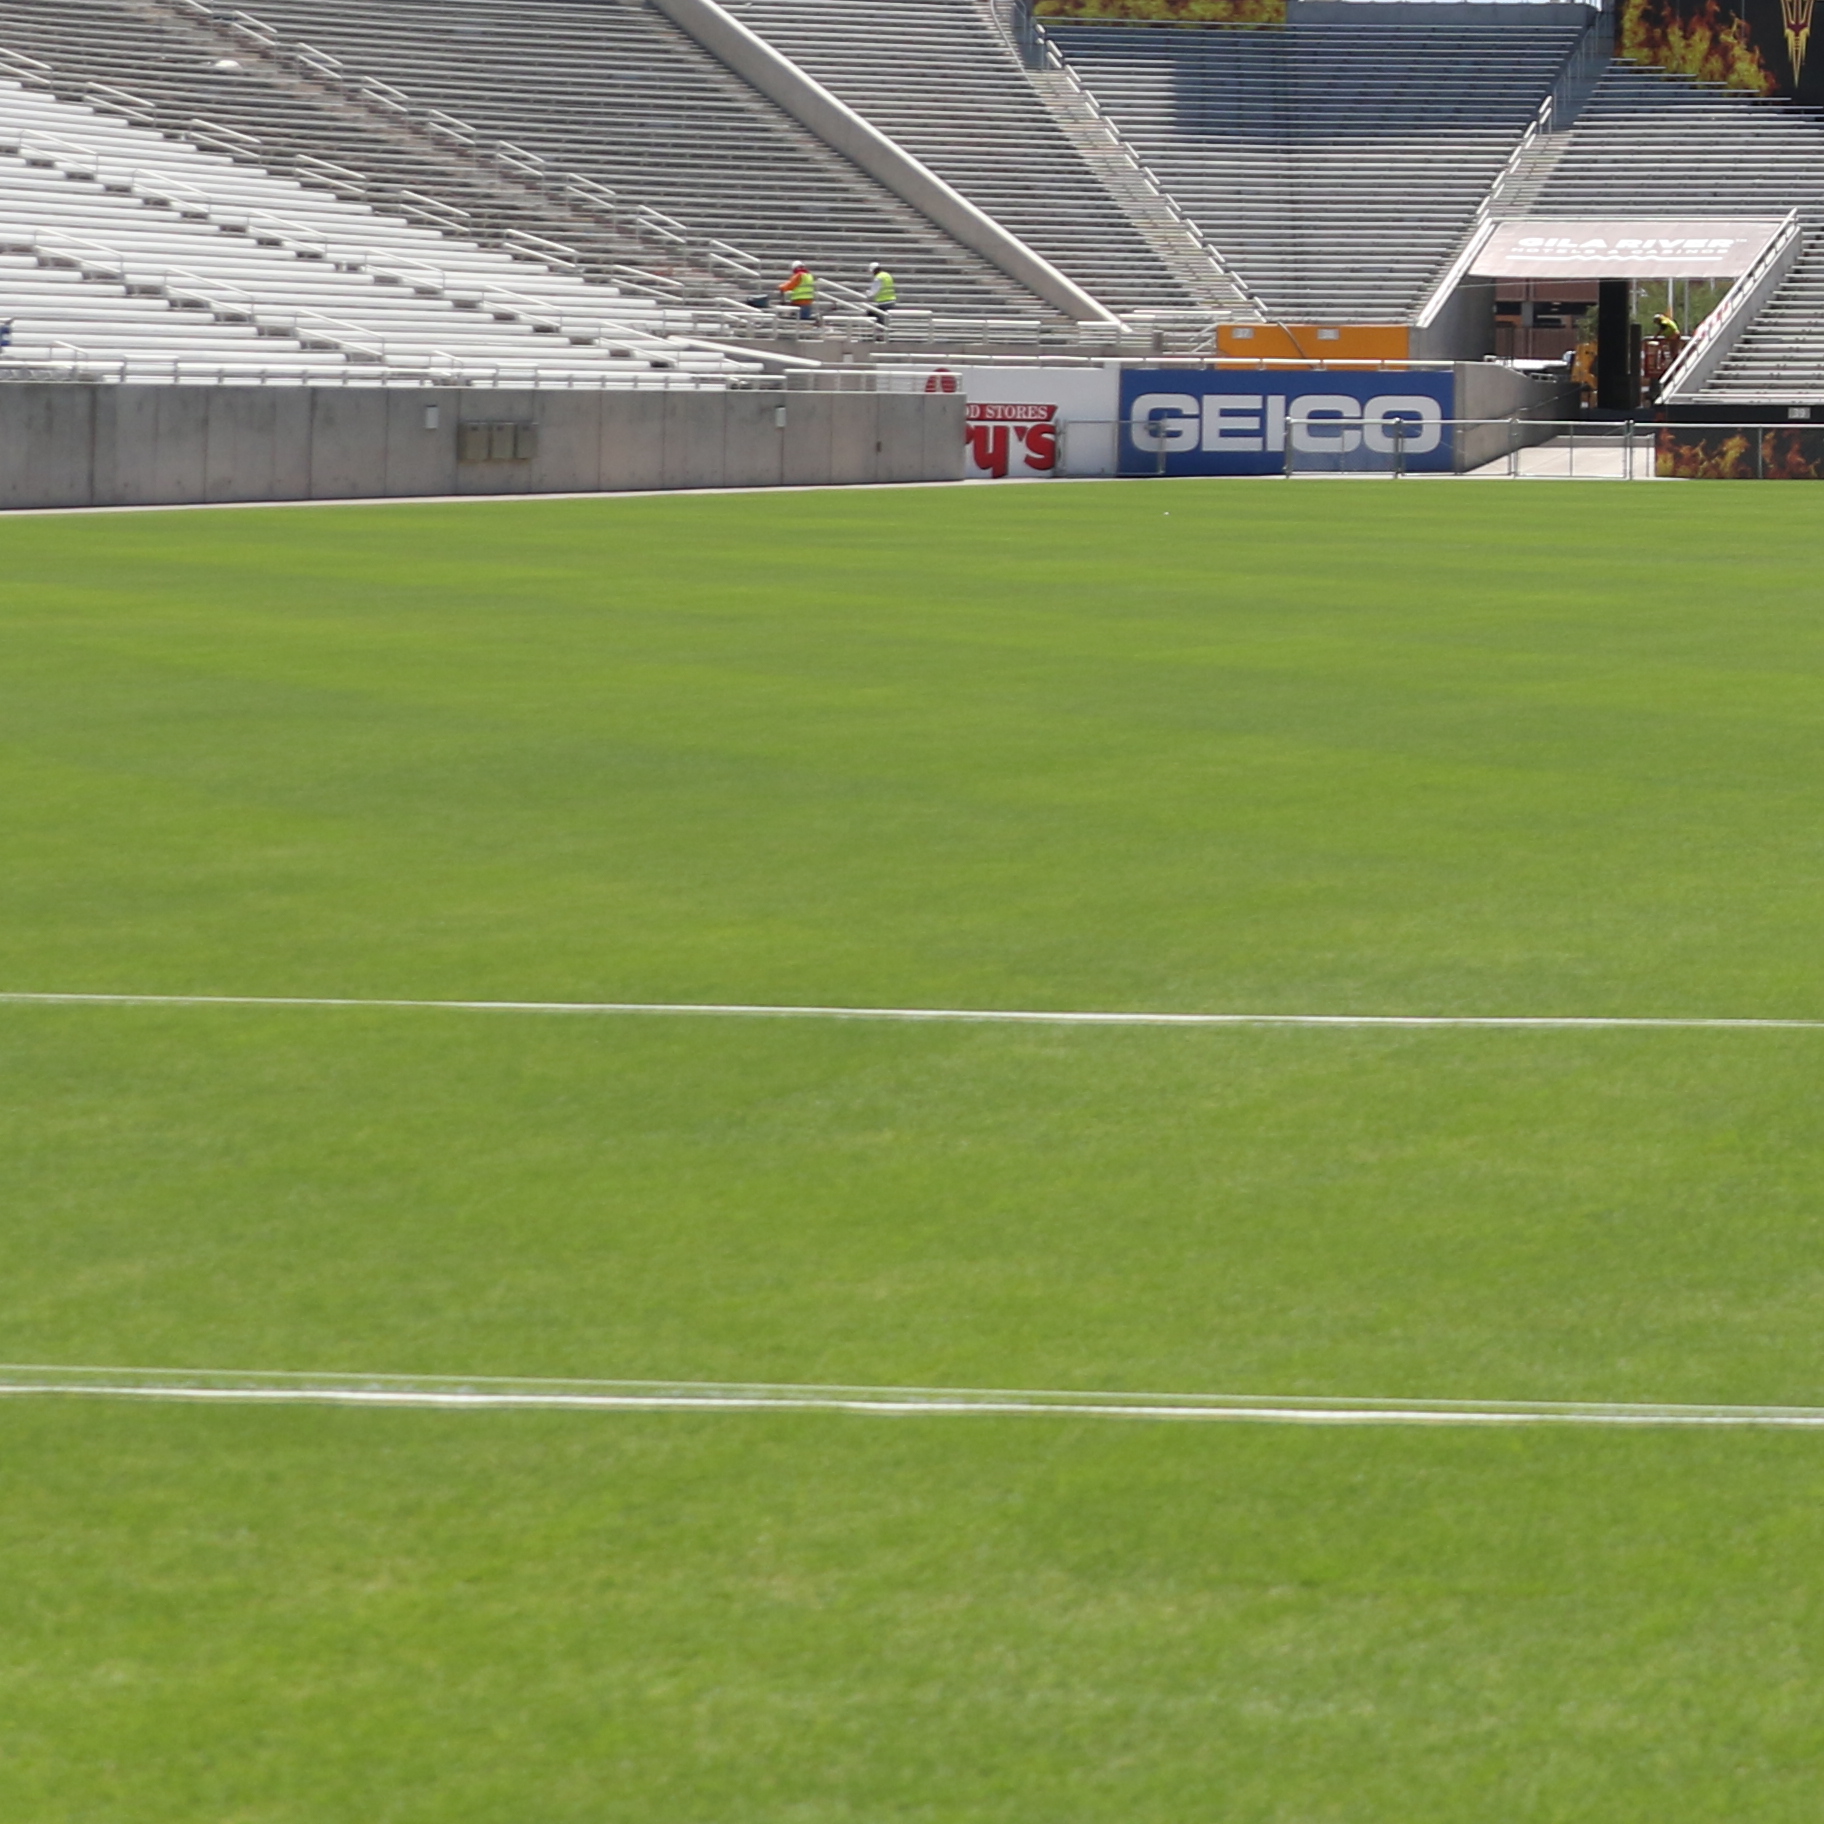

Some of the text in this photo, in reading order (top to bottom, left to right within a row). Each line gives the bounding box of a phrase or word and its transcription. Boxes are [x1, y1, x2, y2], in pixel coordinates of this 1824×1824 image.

[1518, 237, 1734, 248] GILA RIVER
[985, 405, 1048, 420] STORES
[1131, 393, 1442, 455] GEICO
